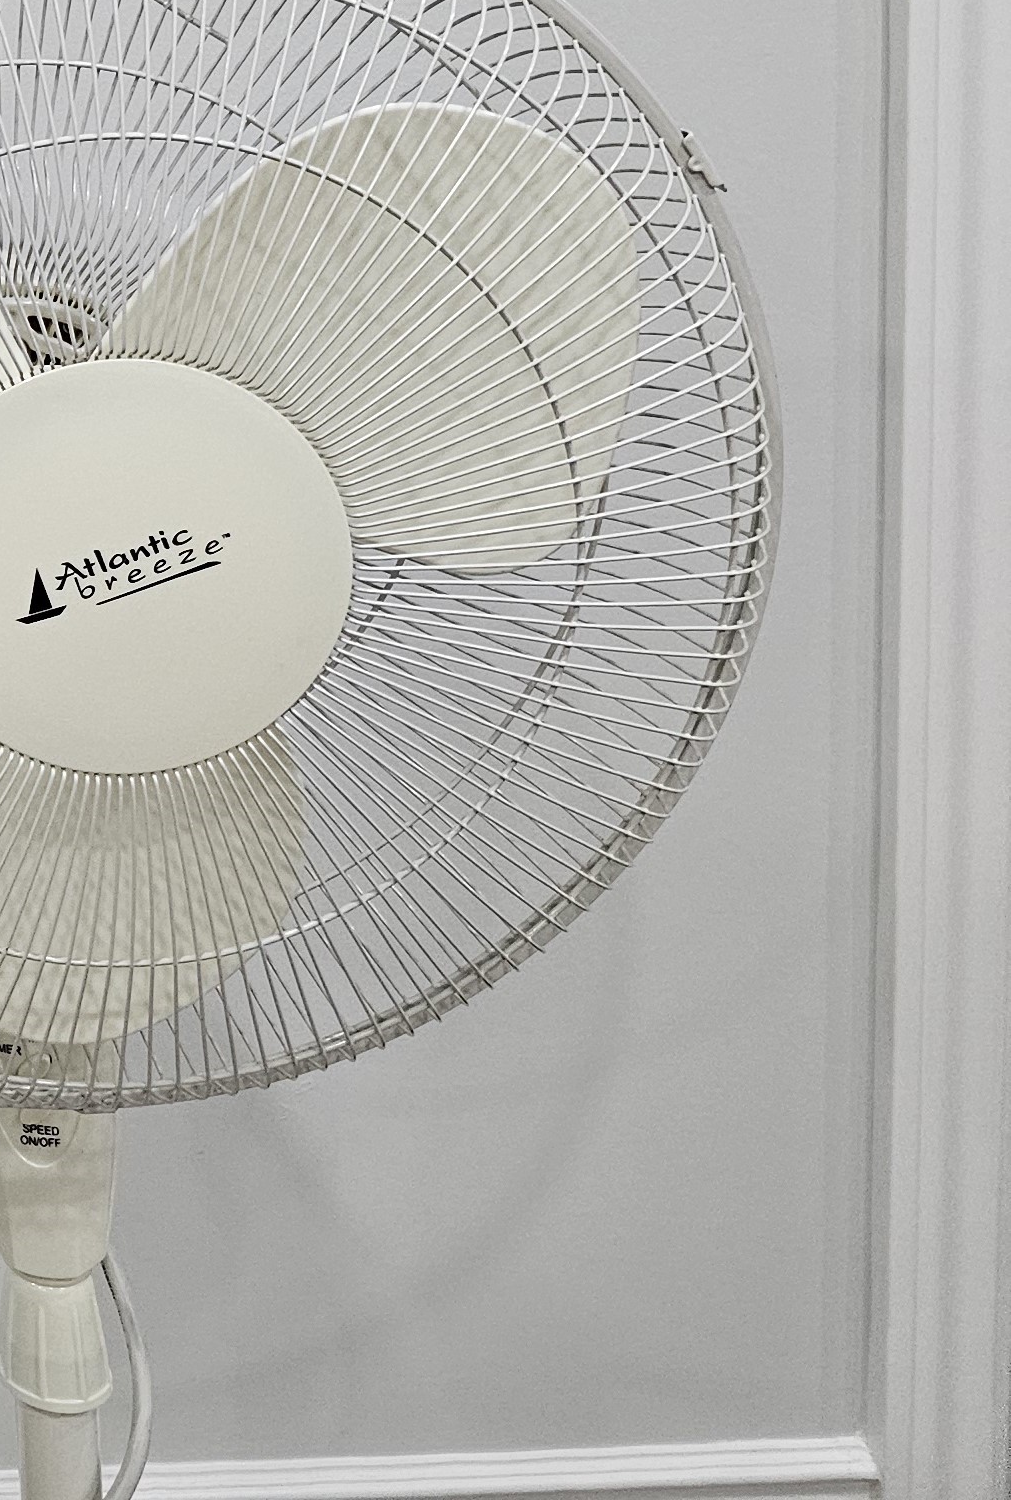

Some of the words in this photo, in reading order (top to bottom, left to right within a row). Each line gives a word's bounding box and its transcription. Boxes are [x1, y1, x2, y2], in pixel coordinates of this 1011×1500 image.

[54, 529, 193, 591] Atlantic
[22, 1123, 60, 1136] SPEED
[19, 1134, 61, 1148] ON/OFF
